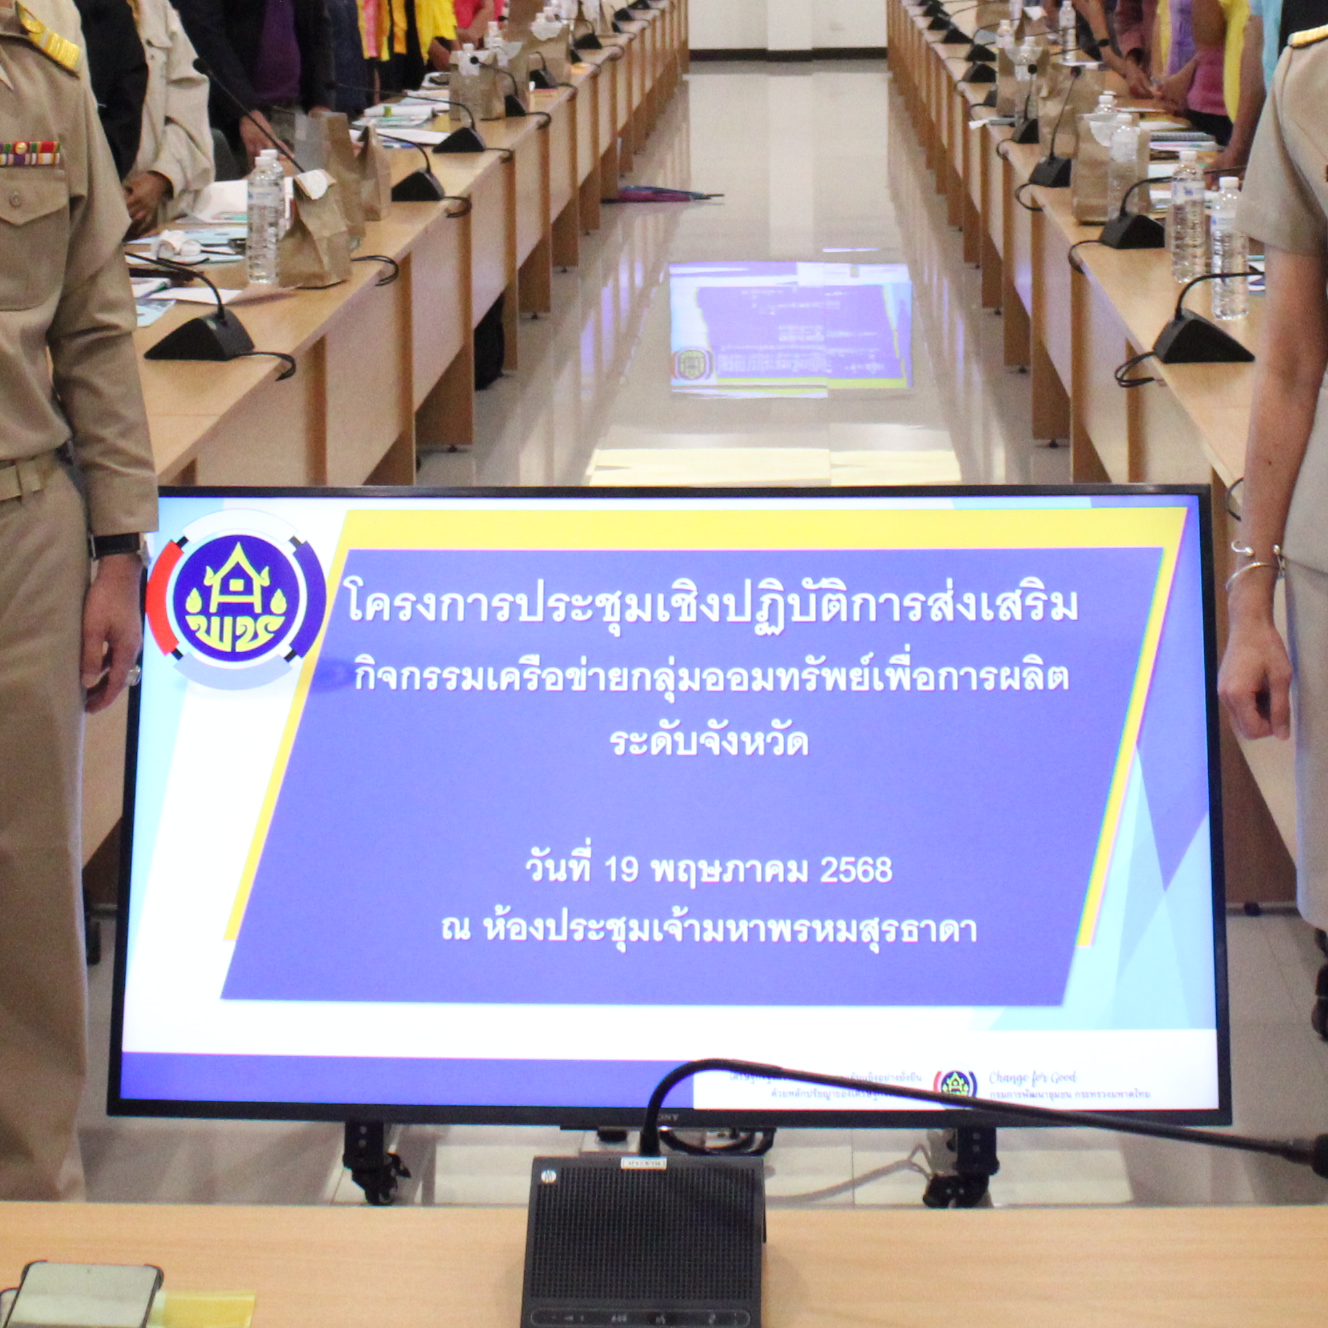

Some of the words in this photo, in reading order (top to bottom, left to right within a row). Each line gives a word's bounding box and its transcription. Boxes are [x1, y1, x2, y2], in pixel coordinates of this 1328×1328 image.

[343, 575, 1078, 637] โครงการประชุมเชิงปฏิบัติการส่งเสริม
[354, 643, 1069, 704] กิจกรรมเครือข่ายกลุ่มออมทรัพย์เพื่อการผลิต
[609, 718, 809, 756] ระดับจังหวัด
[525, 837, 592, 882] วันที่
[605, 855, 639, 883] 19
[650, 859, 809, 890] พฤษภาคม
[820, 856, 893, 884] 2568
[441, 917, 471, 940] ณ
[482, 904, 977, 955] ห้องประชุมเจ้ามหาพรหมสุรธาดา
[989, 1071, 1028, 1085] Change
[1031, 1071, 1048, 1087] for
[1050, 1071, 1077, 1083] Good
